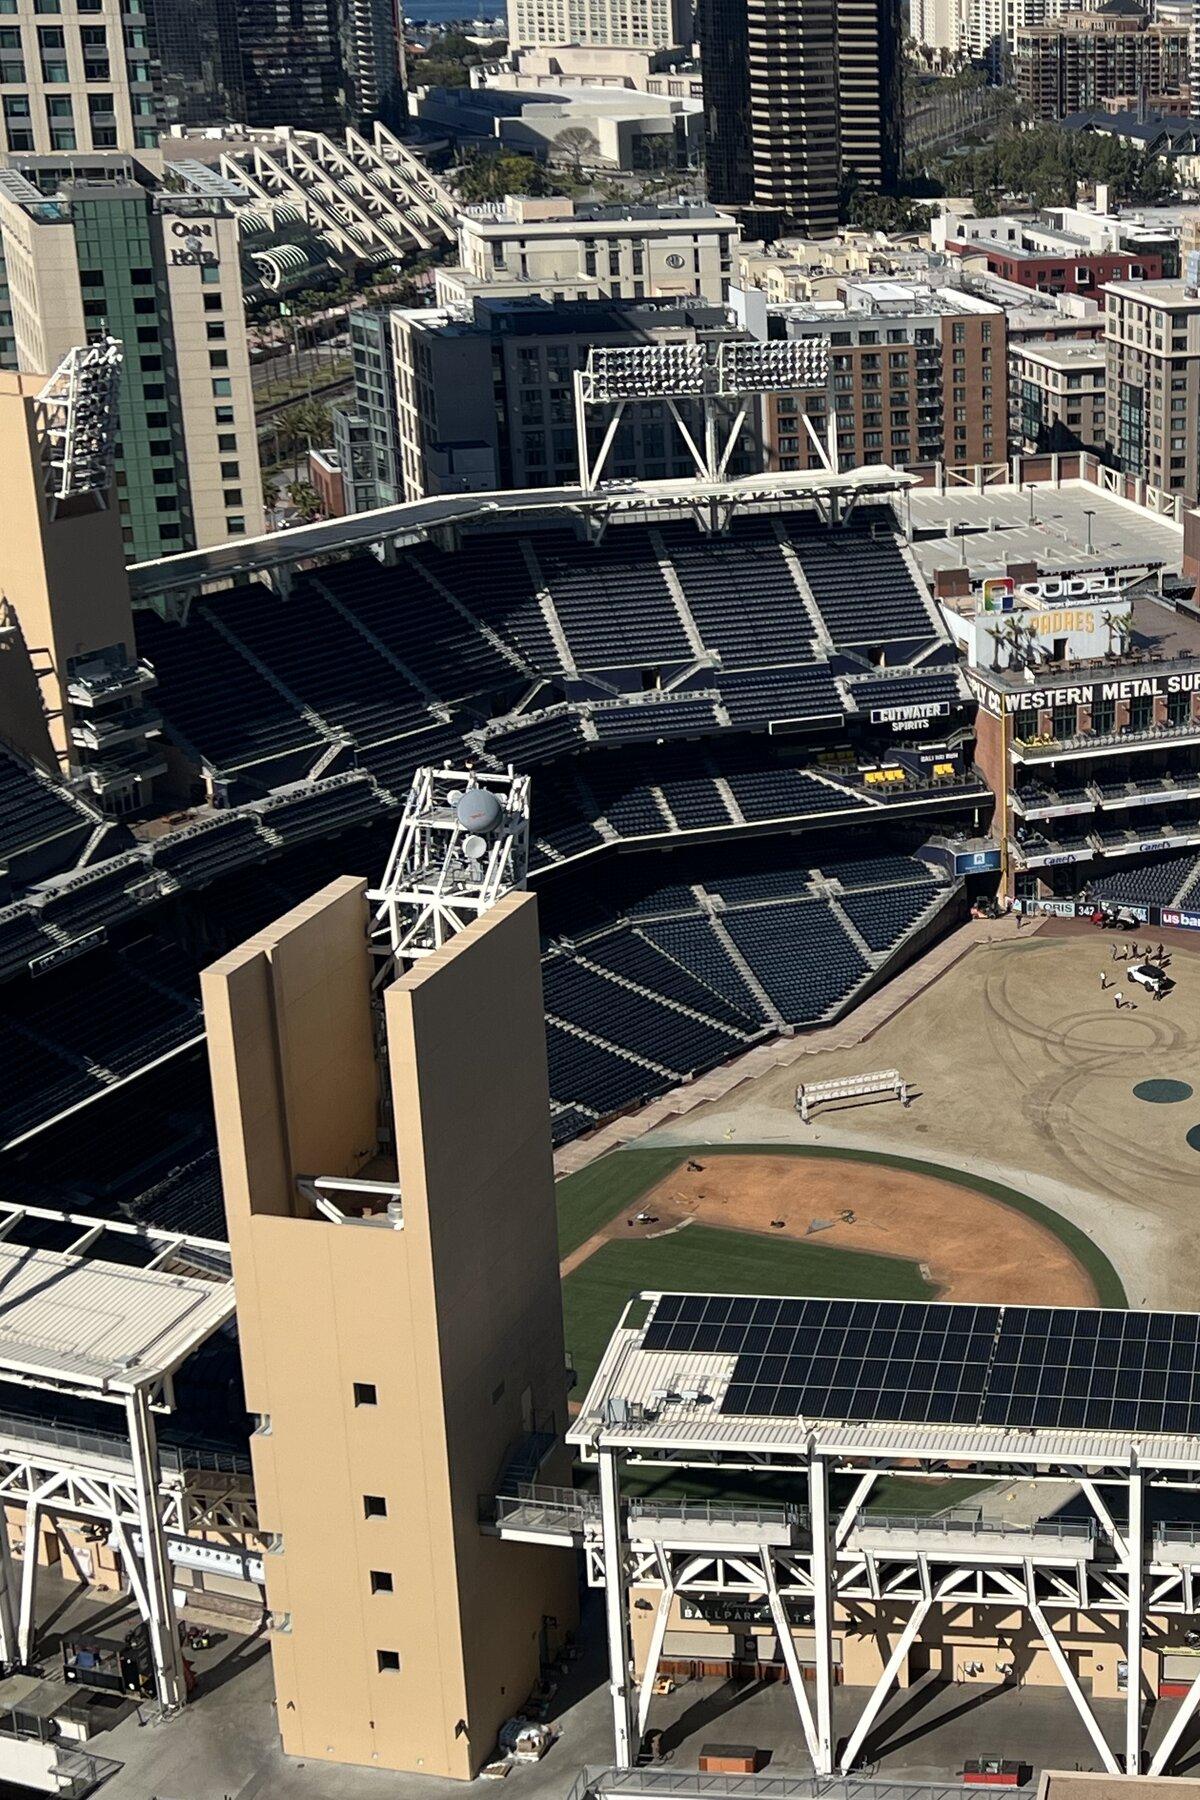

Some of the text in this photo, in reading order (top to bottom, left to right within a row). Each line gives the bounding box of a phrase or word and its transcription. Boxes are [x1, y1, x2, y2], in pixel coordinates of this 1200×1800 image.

[1005, 685, 1094, 711] WESTERN
[1102, 677, 1163, 701] METAL
[880, 705, 941, 722] CUTWATER
[892, 719, 930, 732] SPIRITS
[1078, 905, 1095, 917] 347
